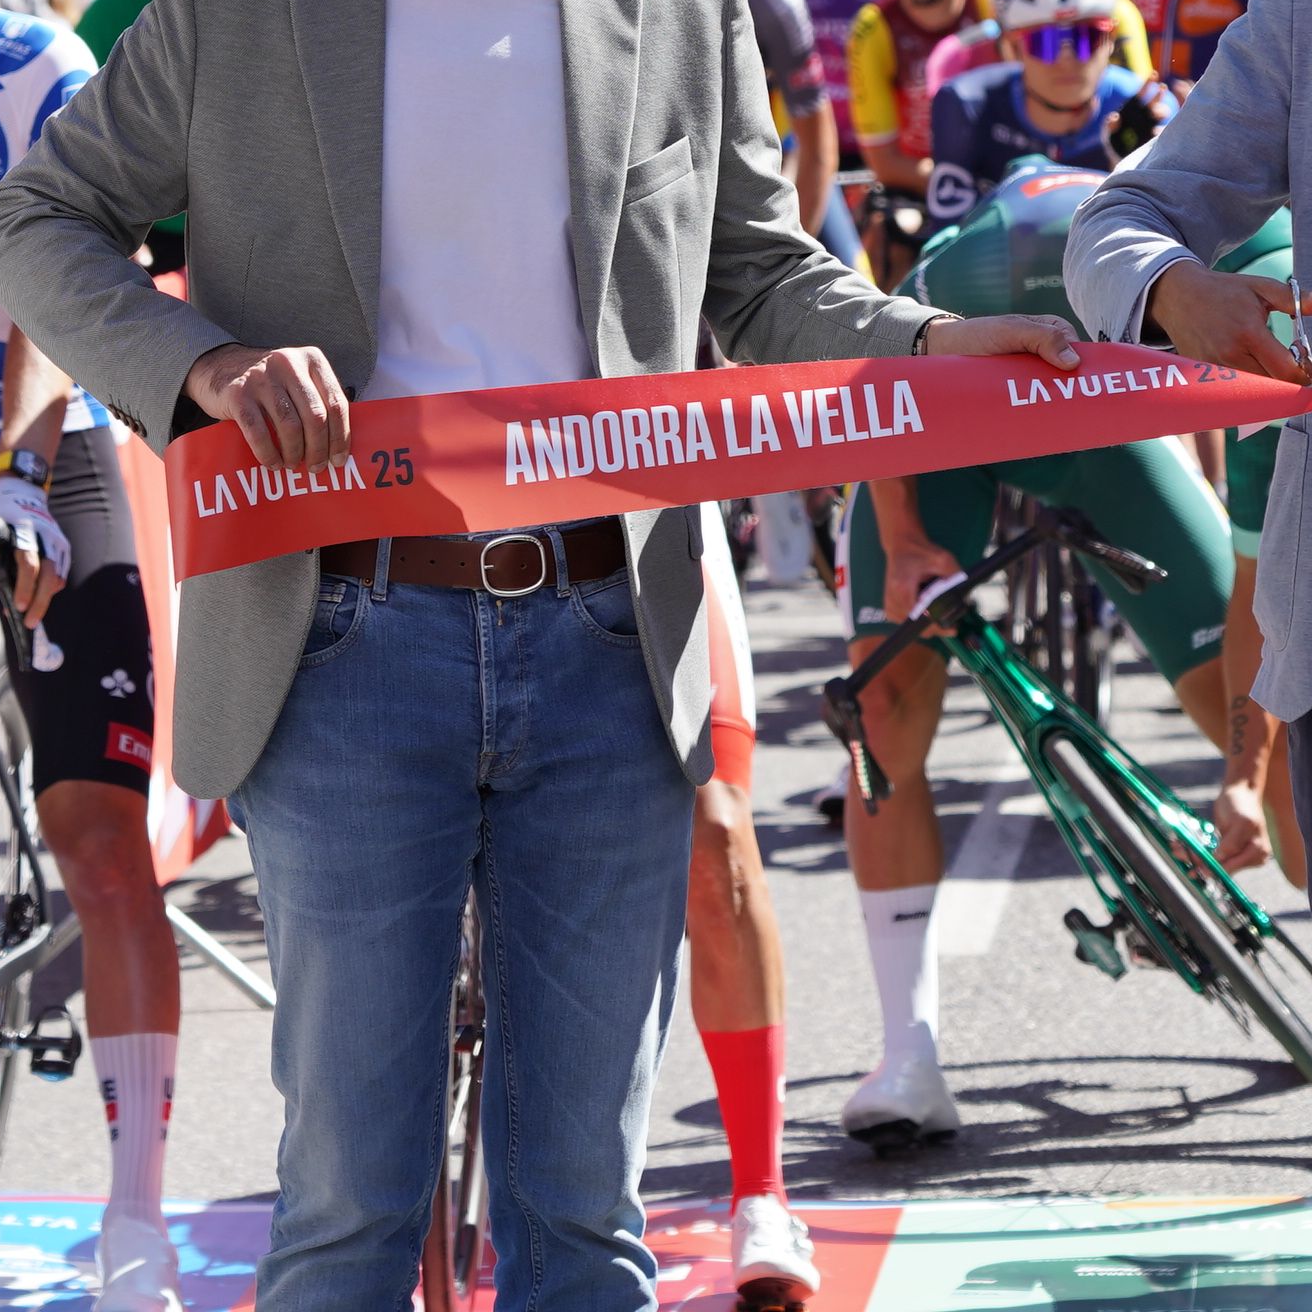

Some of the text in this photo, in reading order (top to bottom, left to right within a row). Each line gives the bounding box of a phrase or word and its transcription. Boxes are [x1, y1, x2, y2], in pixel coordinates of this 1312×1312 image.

[1007, 363, 1237, 408] LA VUELTA 25
[505, 380, 924, 486] ANDORRA LA VELLA
[193, 472, 238, 518] LA
[371, 447, 414, 489] 25
